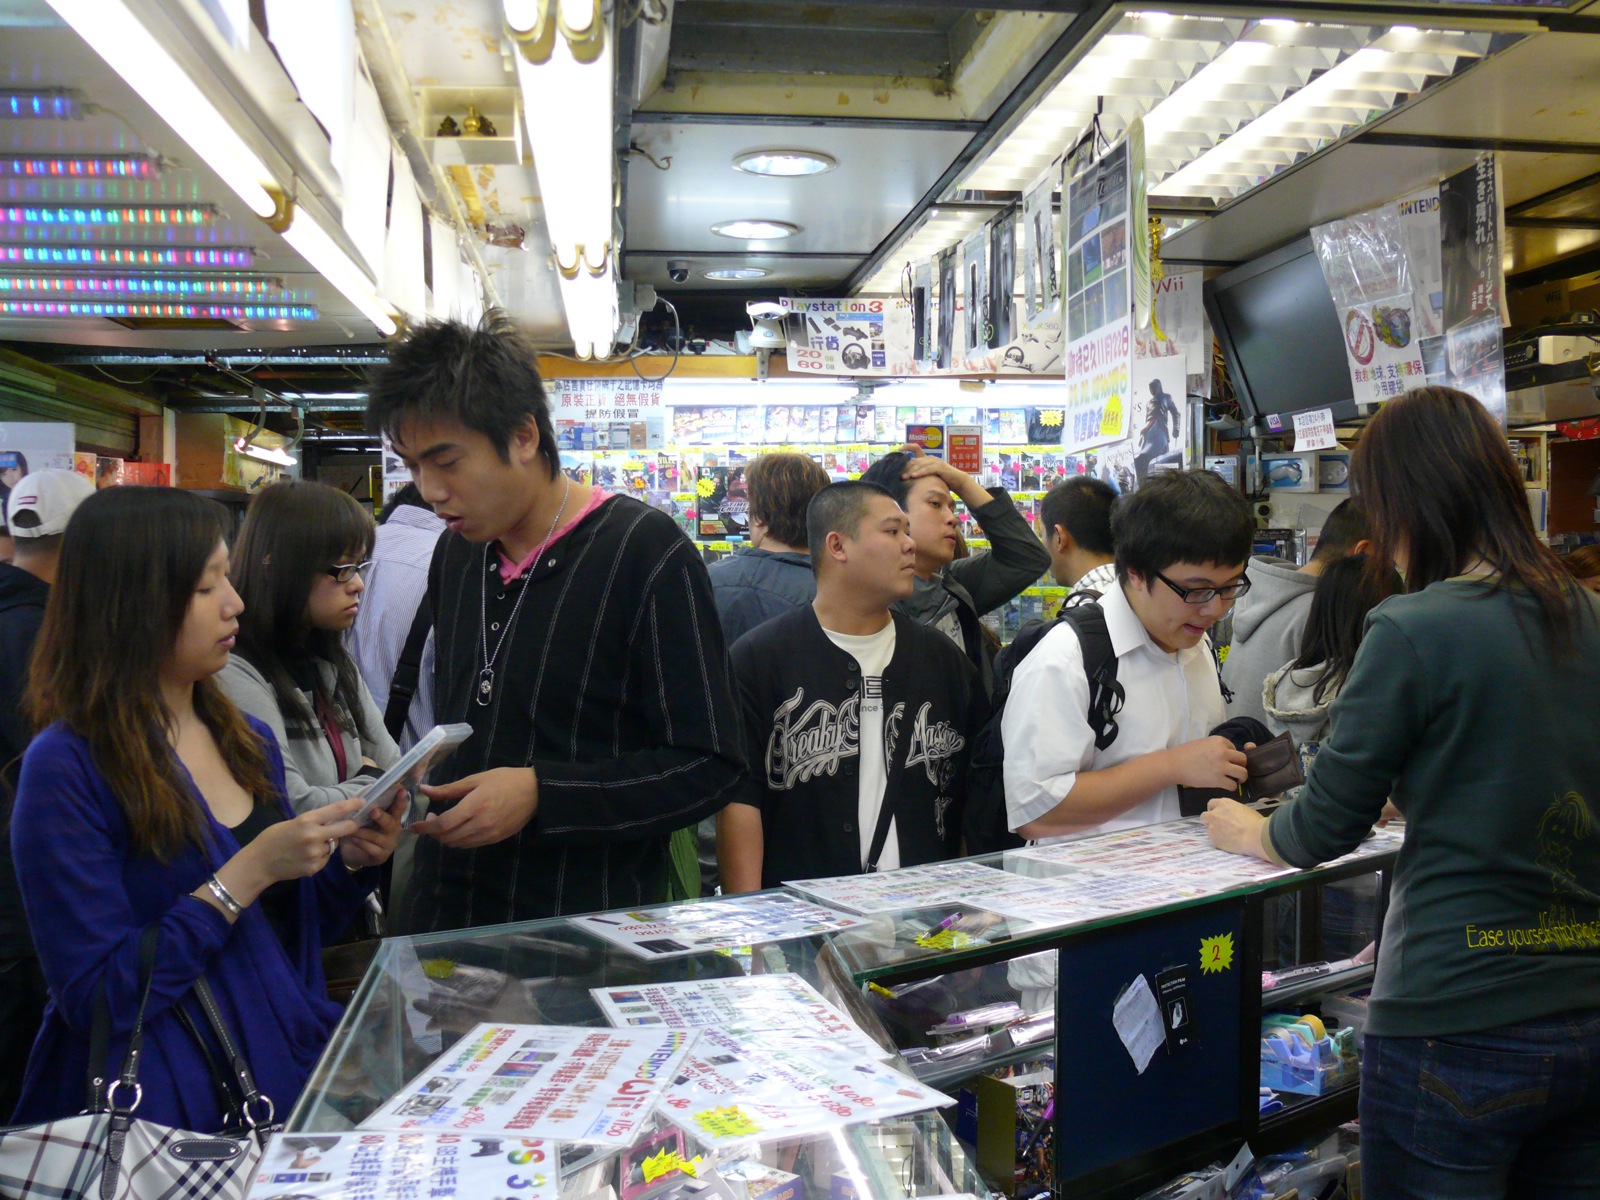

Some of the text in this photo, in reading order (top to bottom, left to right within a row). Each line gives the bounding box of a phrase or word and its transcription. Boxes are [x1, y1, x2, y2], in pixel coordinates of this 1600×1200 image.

[782, 299, 866, 313] Playstation
[868, 301, 883, 313] 3
[810, 336, 840, 351] 行貨
[796, 350, 822, 359] 20
[797, 361, 823, 370] 60
[561, 393, 660, 407] 原裝正貨 絕無假貨
[585, 408, 639, 419] 提防假冒
[1563, 425, 1568, 433] 7
[1593, 427, 1598, 435] 5
[1466, 924, 1505, 949] Ease
[1211, 944, 1221, 963] 2
[634, 1031, 687, 1079] NINTENDO
[506, 1173, 546, 1190] 3
